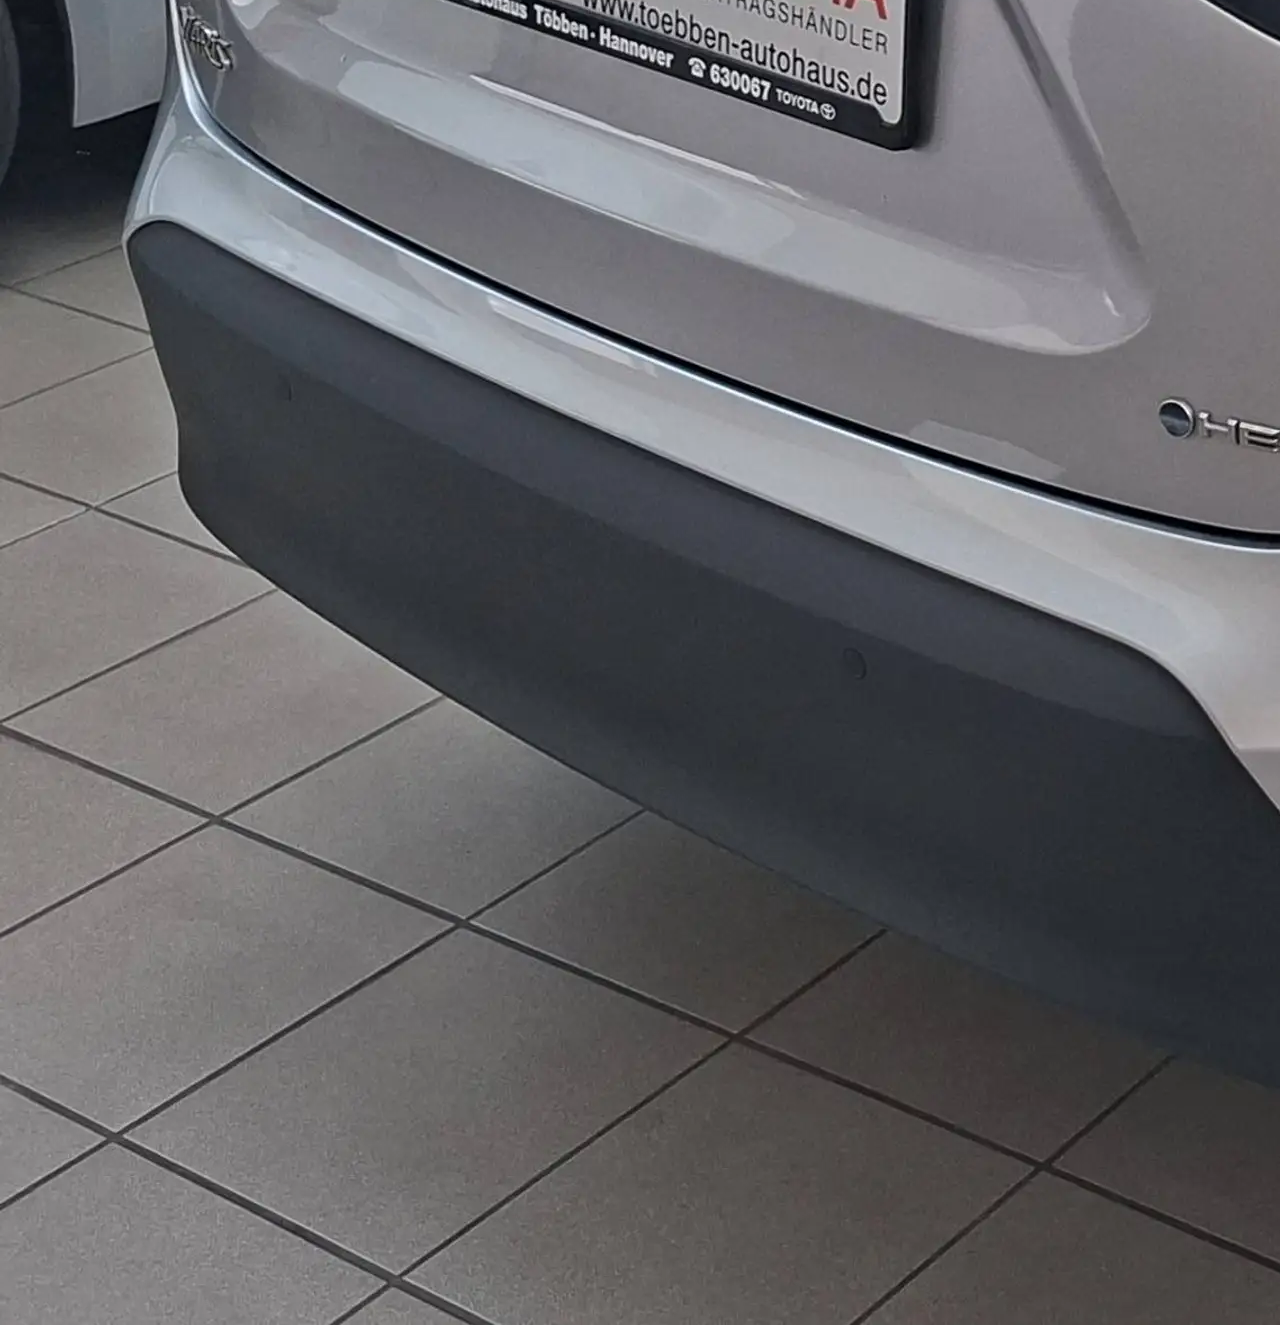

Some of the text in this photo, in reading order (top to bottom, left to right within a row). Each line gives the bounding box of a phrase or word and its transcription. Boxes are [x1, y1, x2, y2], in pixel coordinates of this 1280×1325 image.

[533, 3, 589, 41] Többen
[598, 25, 675, 70] Hannover
[709, 64, 771, 102] 630067
[775, 87, 819, 116] TOYOTA
